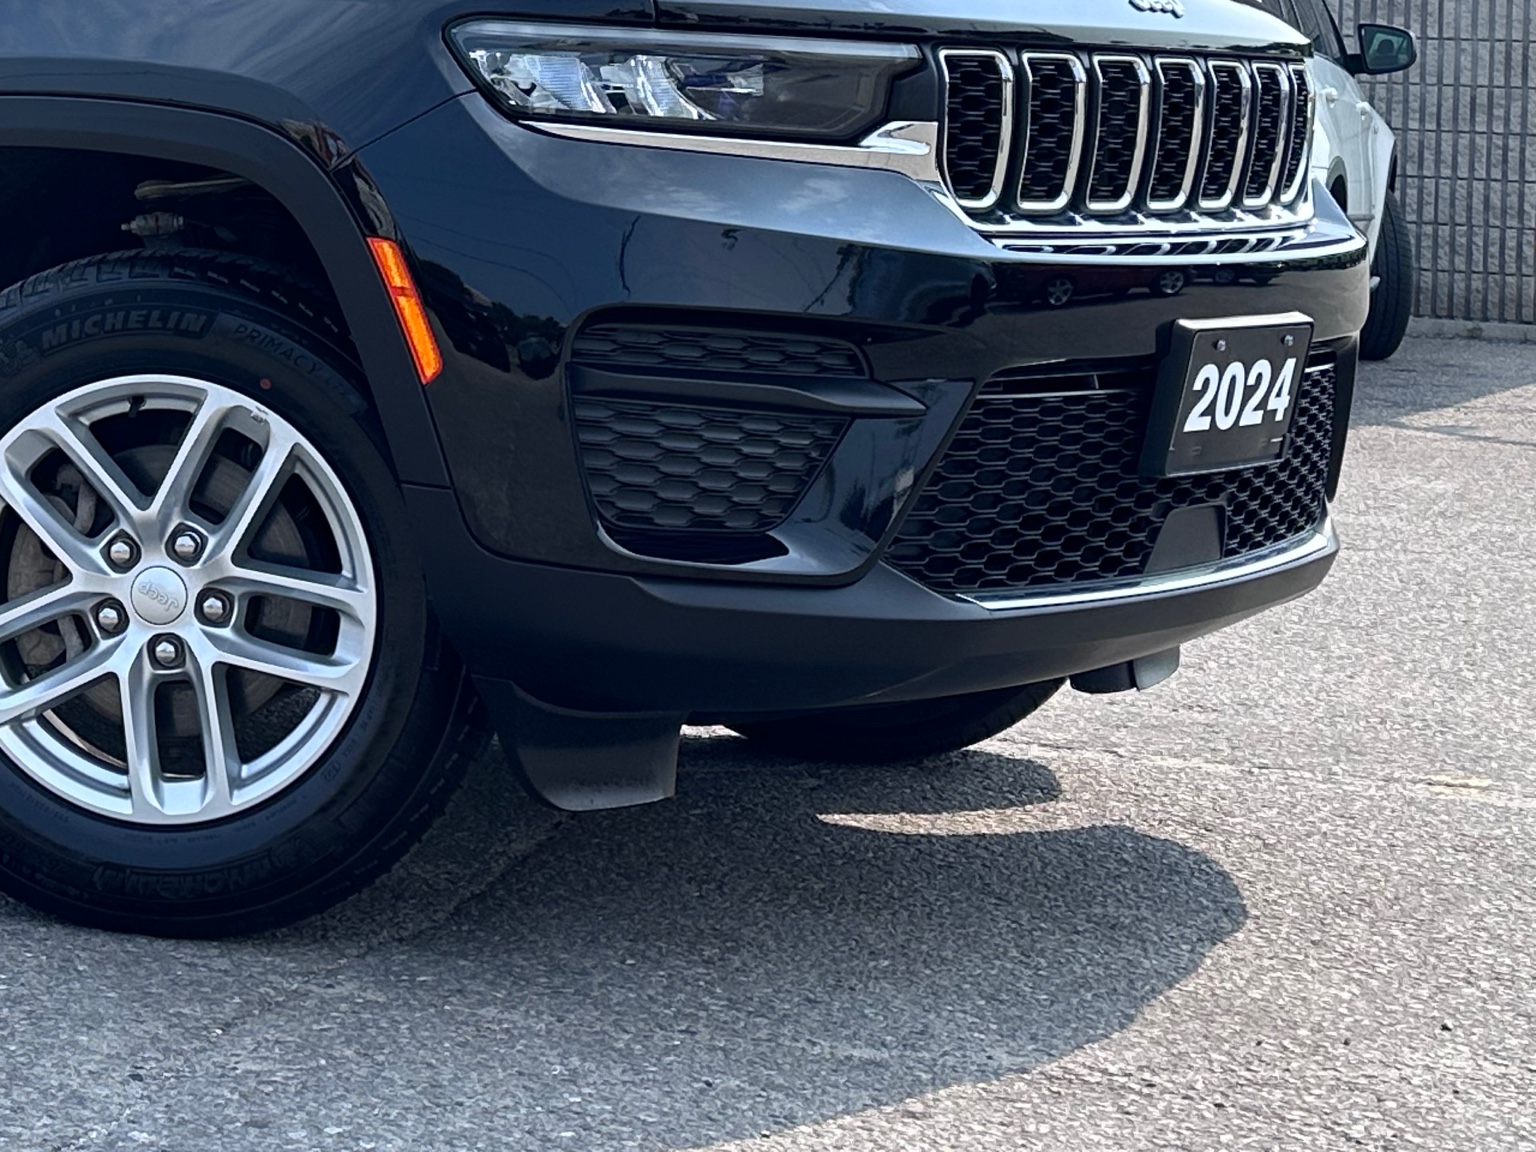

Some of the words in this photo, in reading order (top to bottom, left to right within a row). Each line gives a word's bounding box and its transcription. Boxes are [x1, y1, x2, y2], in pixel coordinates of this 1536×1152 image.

[42, 309, 207, 352] MICHELIN
[233, 323, 321, 375] PRIMACY
[1183, 358, 1297, 432] 2024
[138, 581, 179, 613] Jeep
